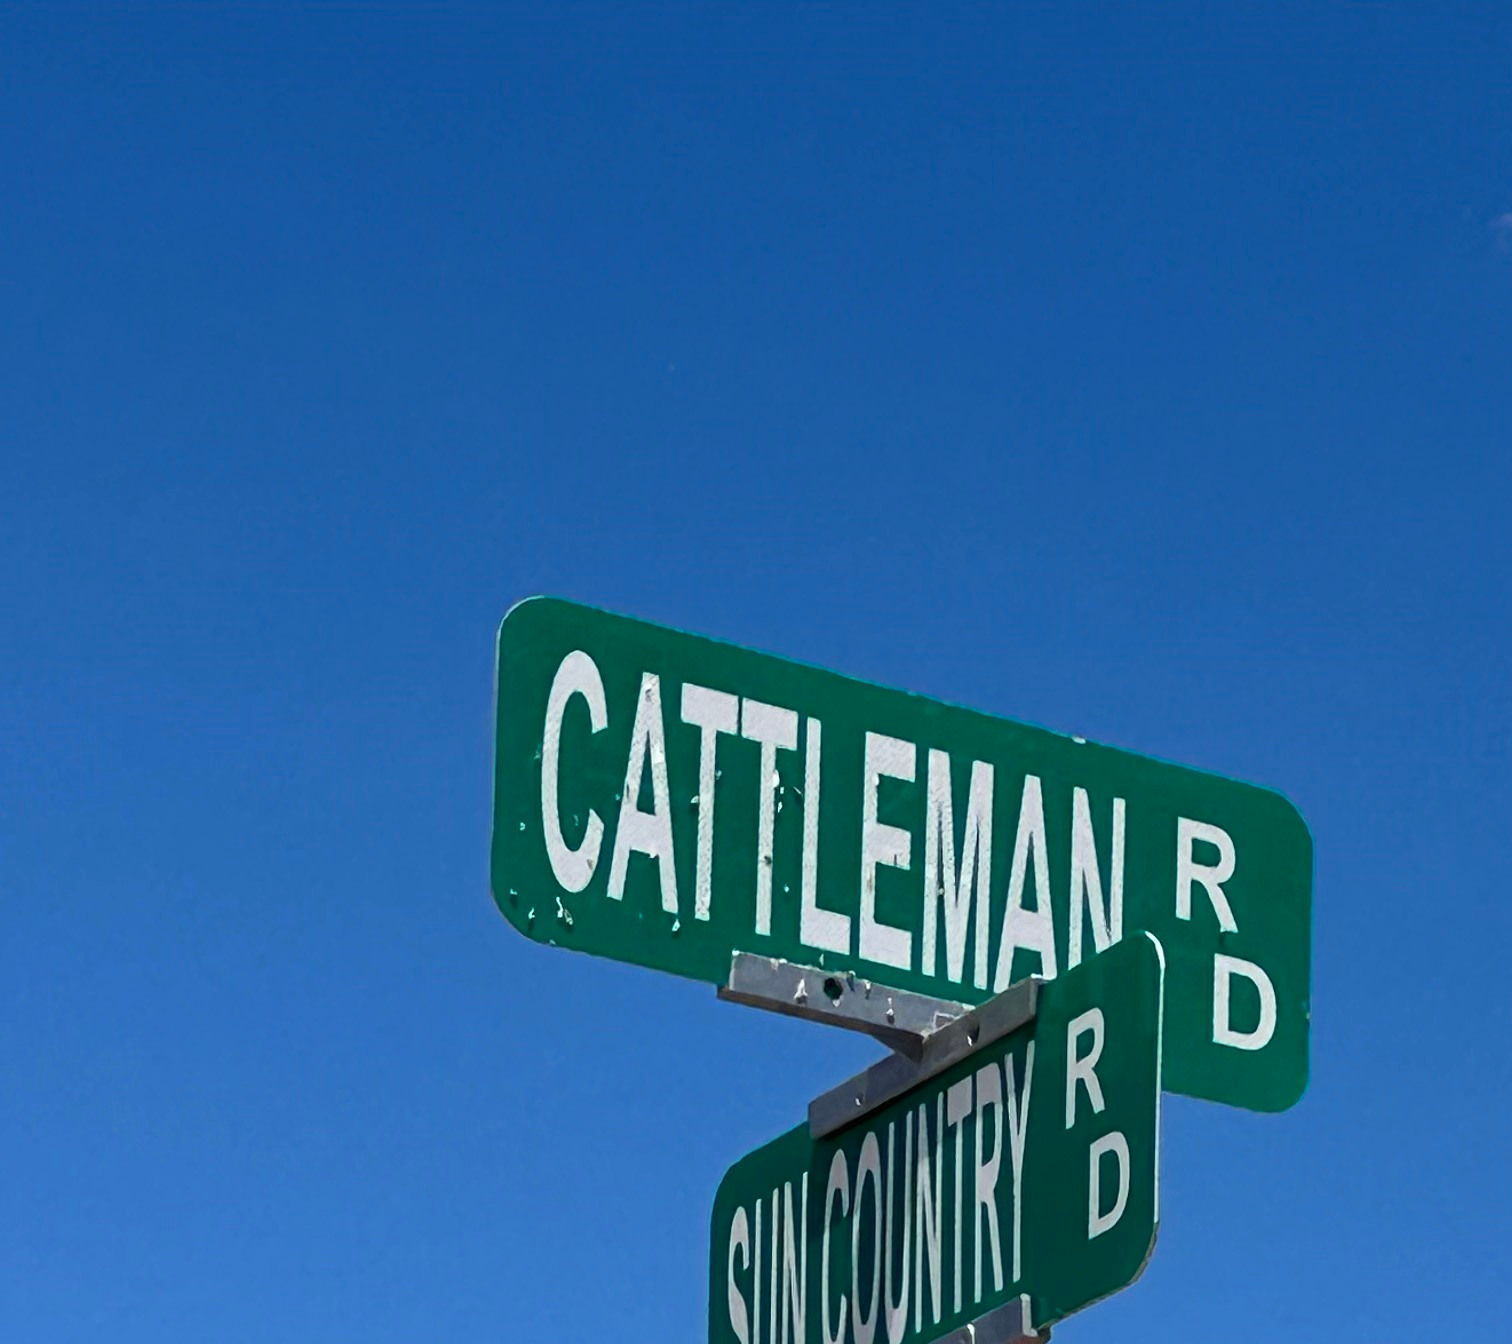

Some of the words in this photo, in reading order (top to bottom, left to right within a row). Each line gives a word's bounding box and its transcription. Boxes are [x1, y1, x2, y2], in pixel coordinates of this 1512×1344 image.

[540, 648, 1127, 993] CATTLEMAN
[1175, 816, 1277, 1051] RD
[1064, 1006, 1132, 1241] RD
